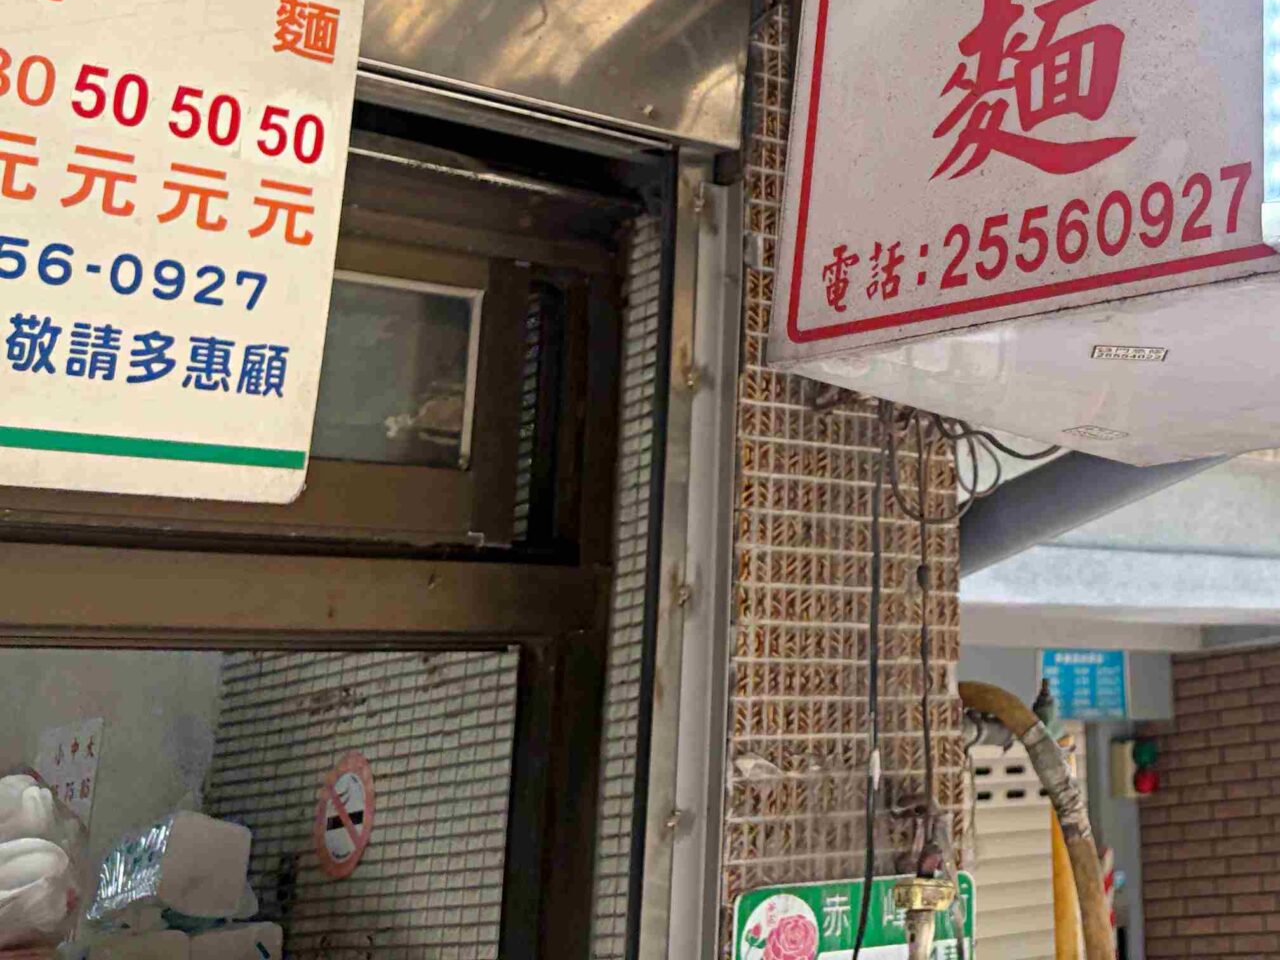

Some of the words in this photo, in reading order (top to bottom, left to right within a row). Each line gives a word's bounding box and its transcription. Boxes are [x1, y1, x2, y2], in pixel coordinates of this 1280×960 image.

[71, 64, 149, 127] 50
[168, 86, 241, 146] 50
[257, 105, 324, 164] 50
[60, 145, 137, 217] 元
[157, 162, 229, 232] 元
[248, 179, 315, 246] 元
[6, 313, 290, 399] 敬請多惠顧
